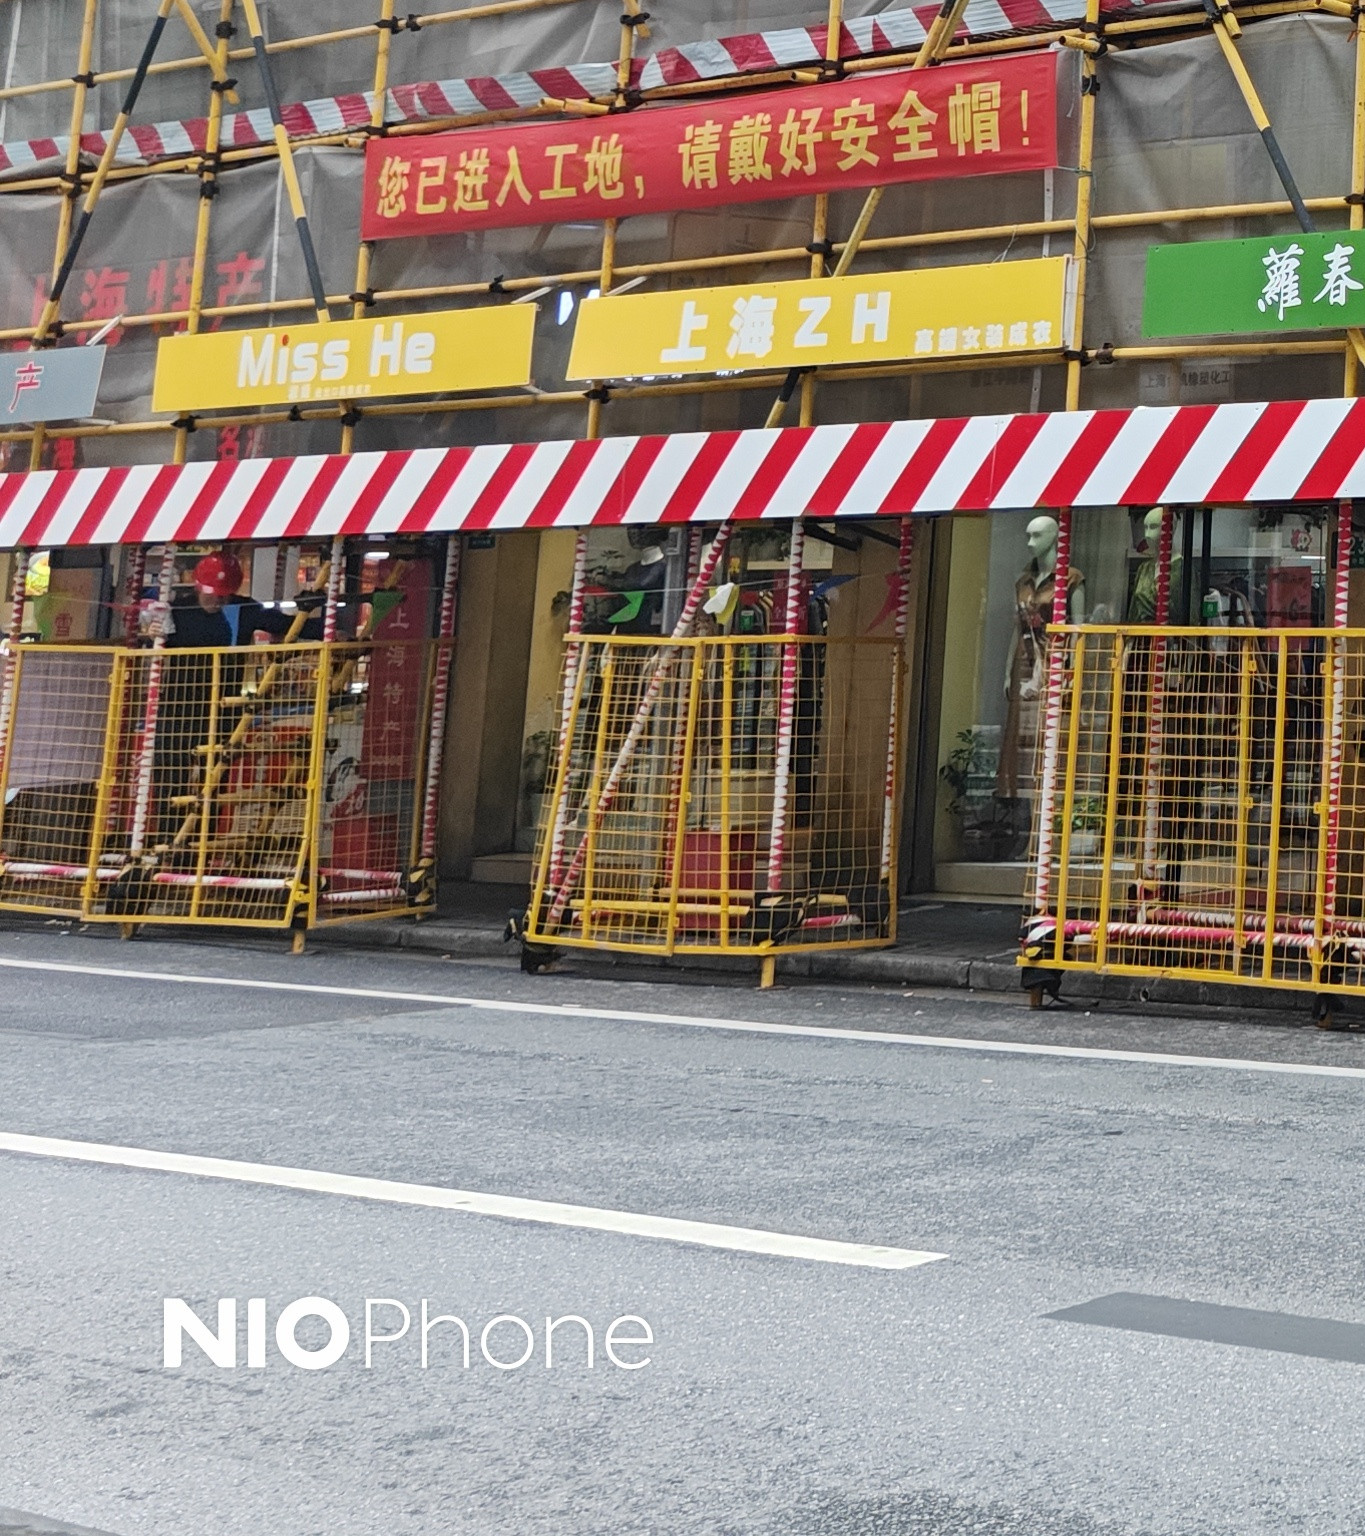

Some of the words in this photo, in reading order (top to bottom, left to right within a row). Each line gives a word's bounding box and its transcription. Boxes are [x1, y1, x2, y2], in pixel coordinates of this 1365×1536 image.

[376, 80, 1030, 219] 您已进入工地，请戴好安全帽！
[237, 333, 350, 388] Miss
[370, 322, 436, 377] He
